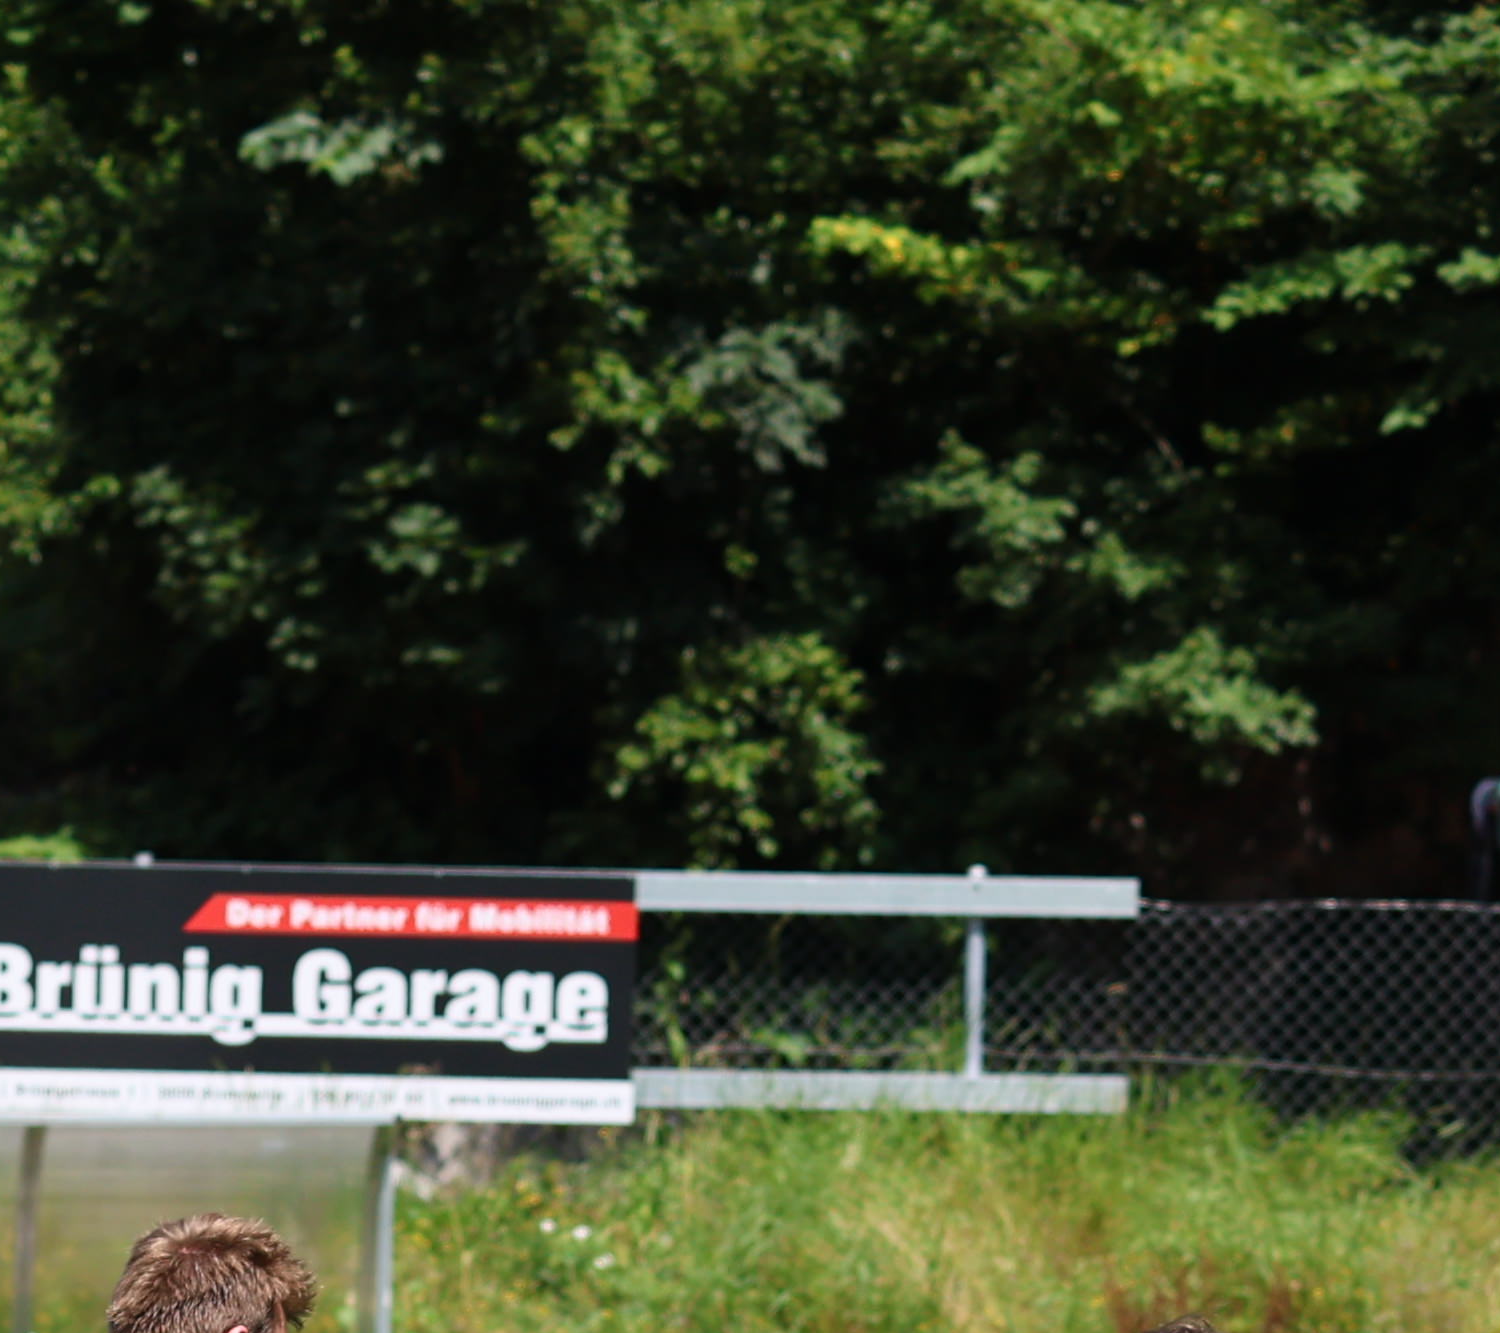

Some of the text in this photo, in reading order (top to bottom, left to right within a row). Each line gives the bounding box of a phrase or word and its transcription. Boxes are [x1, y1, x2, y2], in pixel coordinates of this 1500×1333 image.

[224, 898, 612, 936] Der Partner für Mobilität
[292, 947, 609, 1051] Garage
